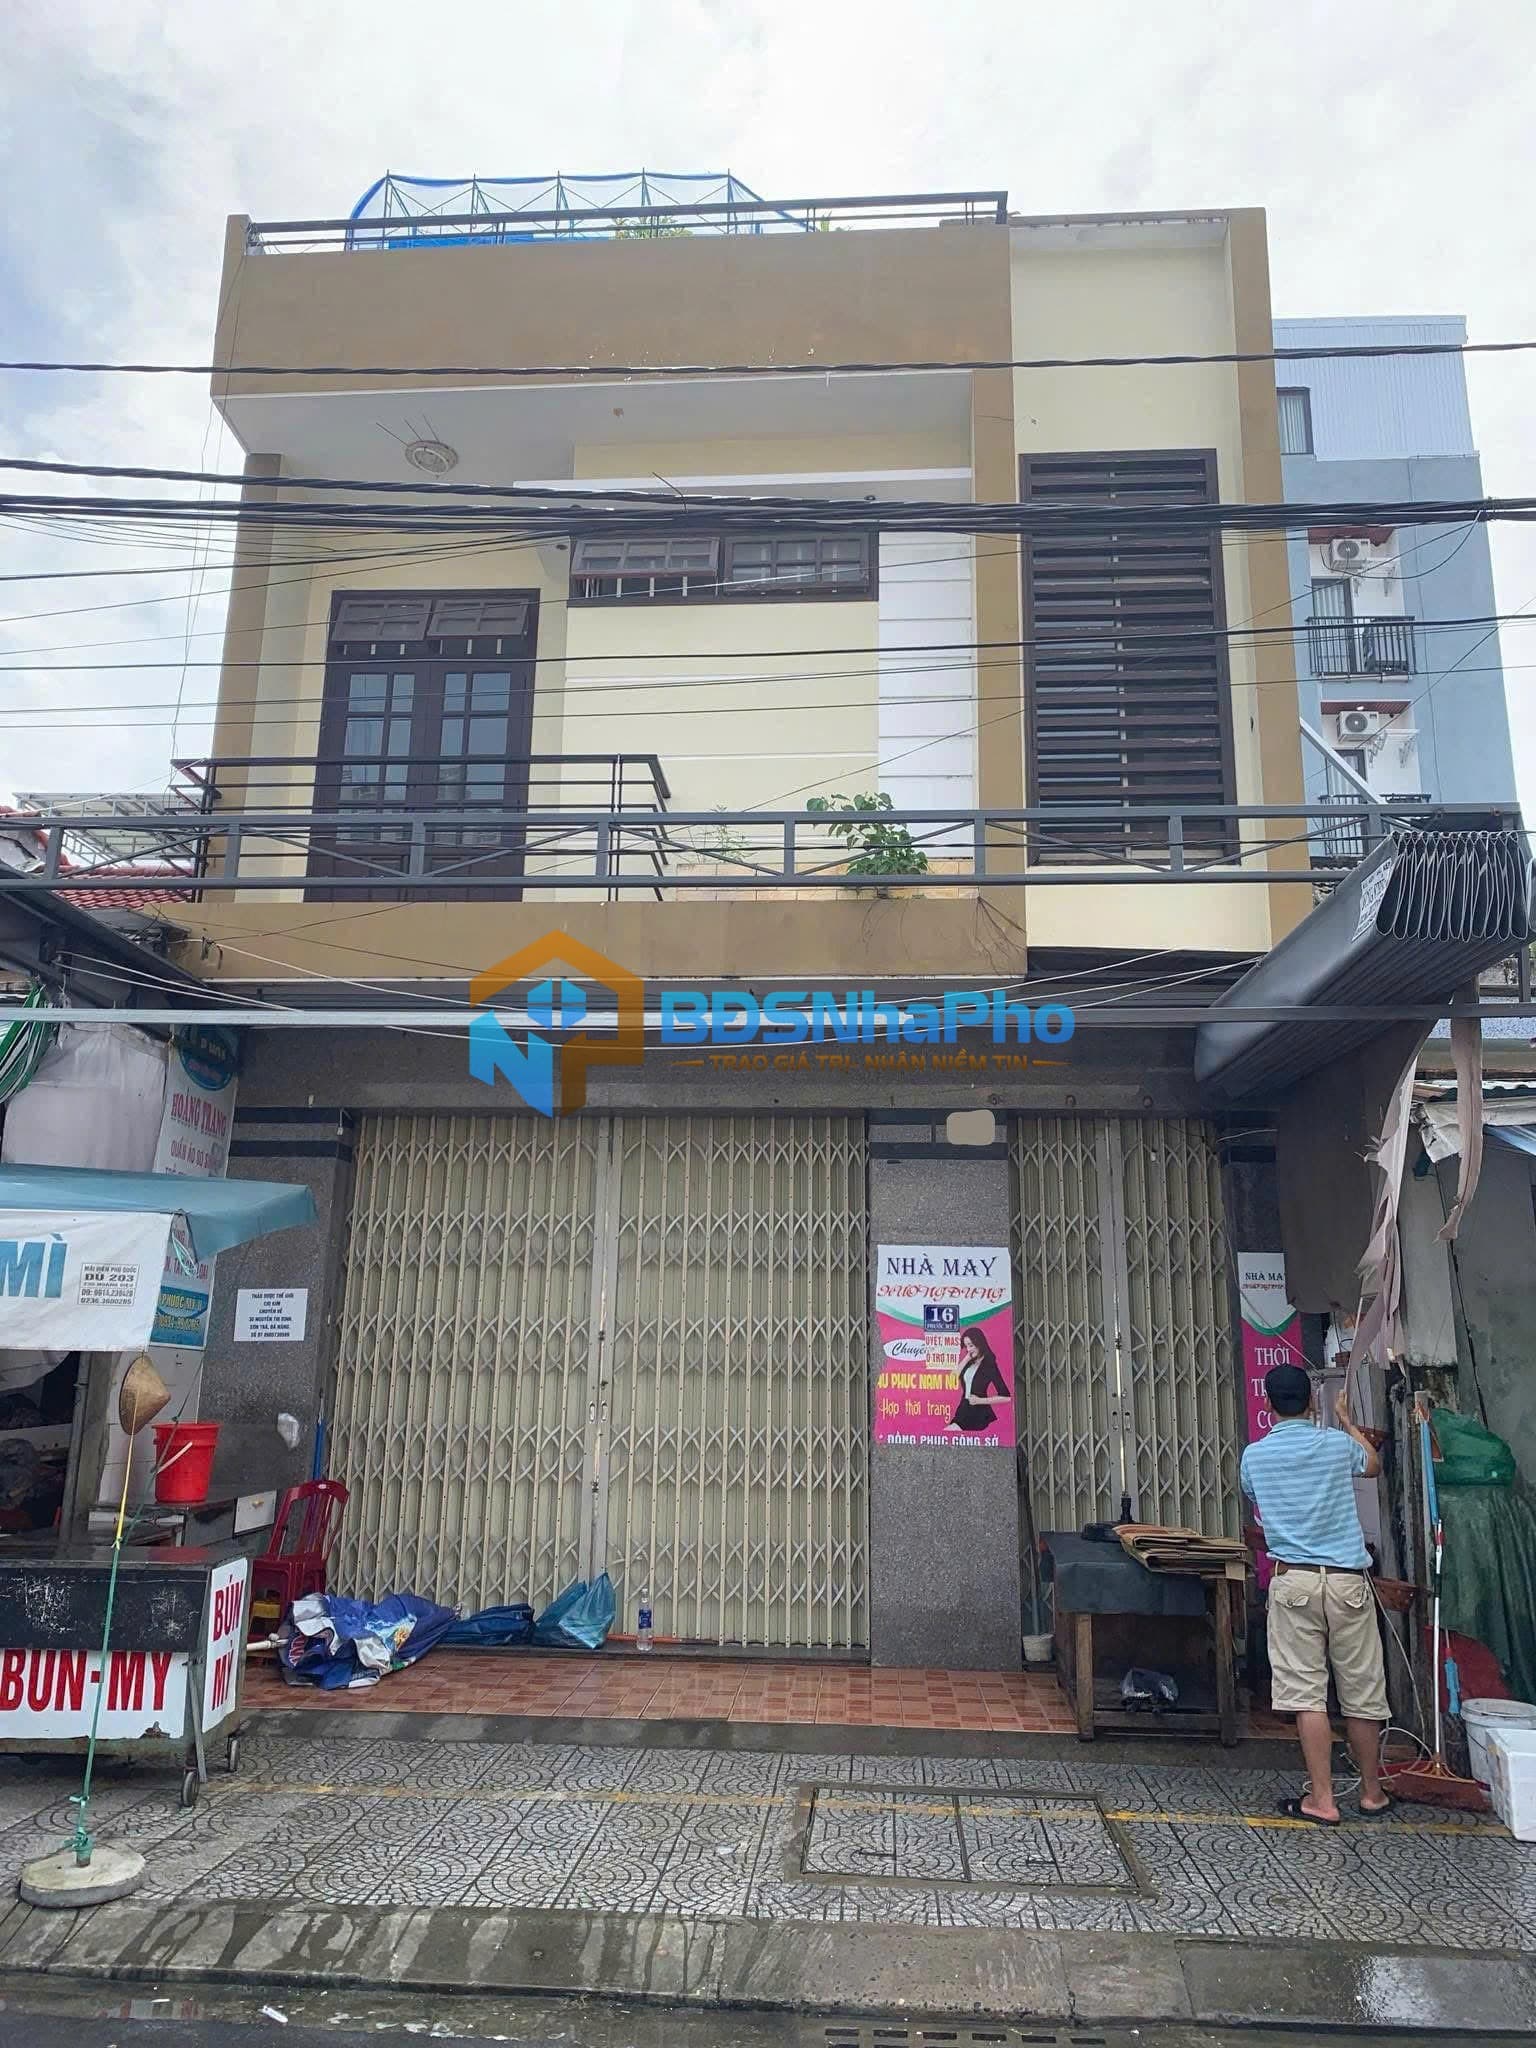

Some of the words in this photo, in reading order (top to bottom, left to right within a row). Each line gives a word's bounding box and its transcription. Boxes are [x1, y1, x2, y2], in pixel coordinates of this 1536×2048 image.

[887, 1253, 935, 1276] NHÀ
[943, 1257, 998, 1277] MAY
[109, 1273, 135, 1282] 203
[931, 1307, 954, 1322] 16
[1255, 1343, 1290, 1366] THỜI
[891, 1372, 917, 1392] PHỤC
[919, 1373, 943, 1390] NAM
[880, 1398, 900, 1420] Hợp
[927, 1400, 951, 1424] trang
[213, 1574, 244, 1642] BÚN
